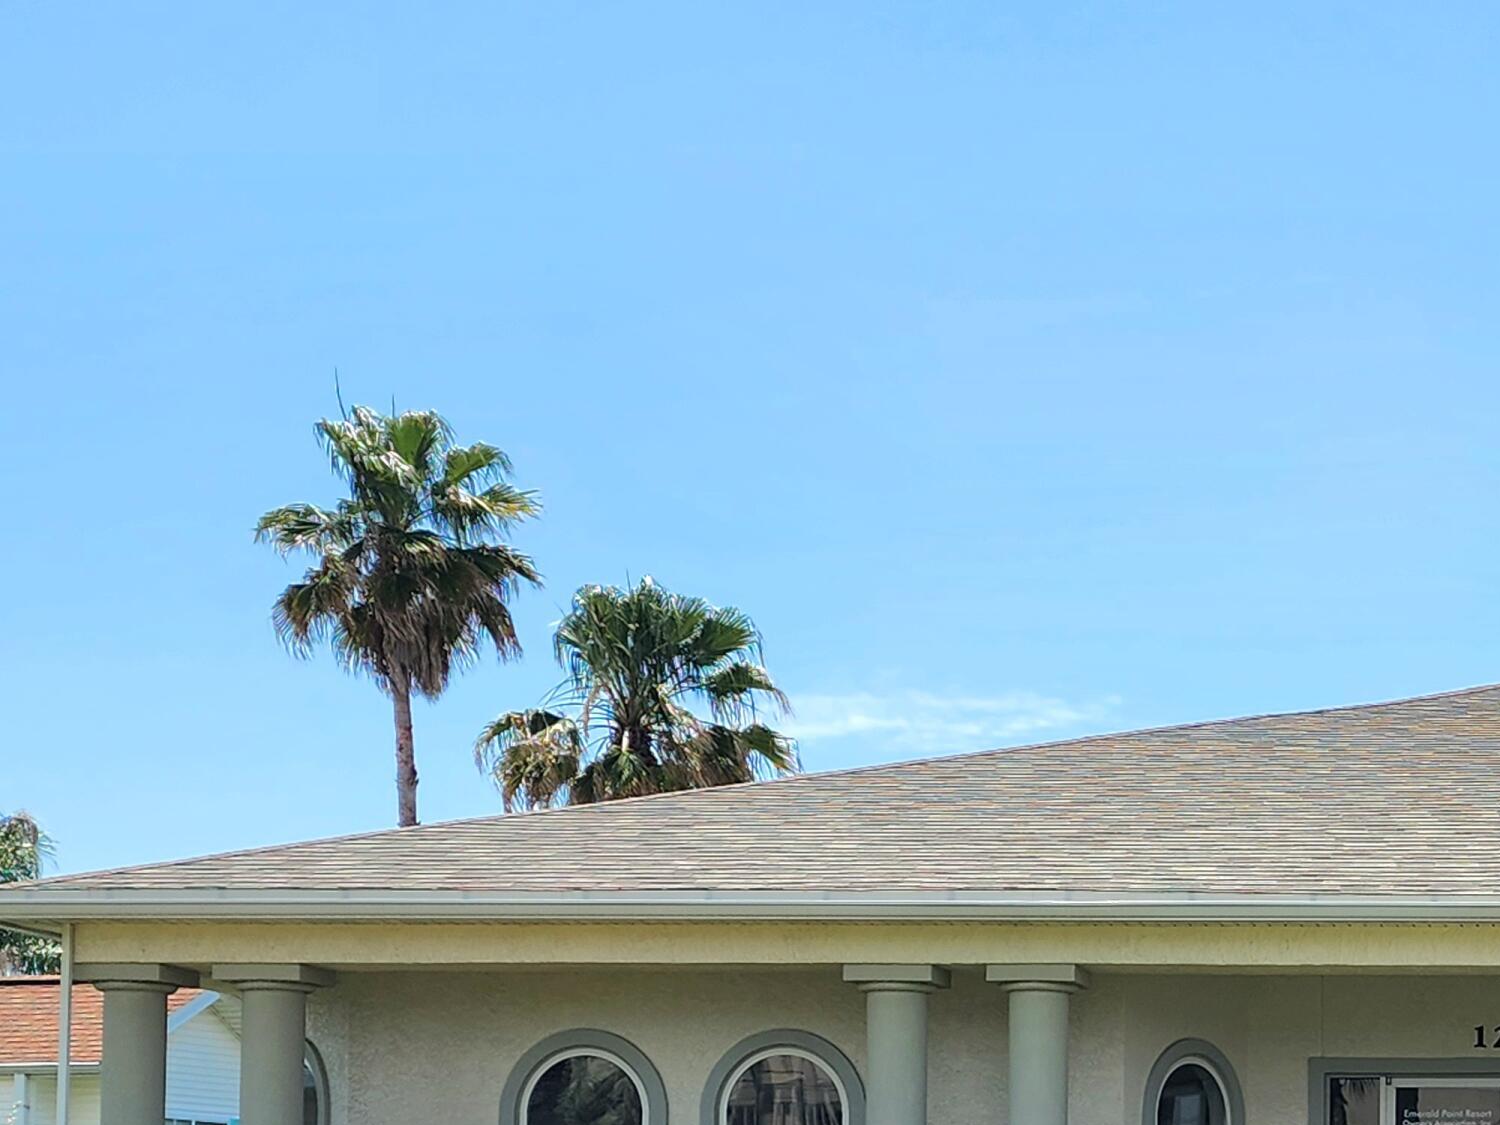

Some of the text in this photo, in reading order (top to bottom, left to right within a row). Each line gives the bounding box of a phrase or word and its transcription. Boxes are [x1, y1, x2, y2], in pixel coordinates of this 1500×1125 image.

[1403, 1109, 1492, 1118] Emerald Point Resort
